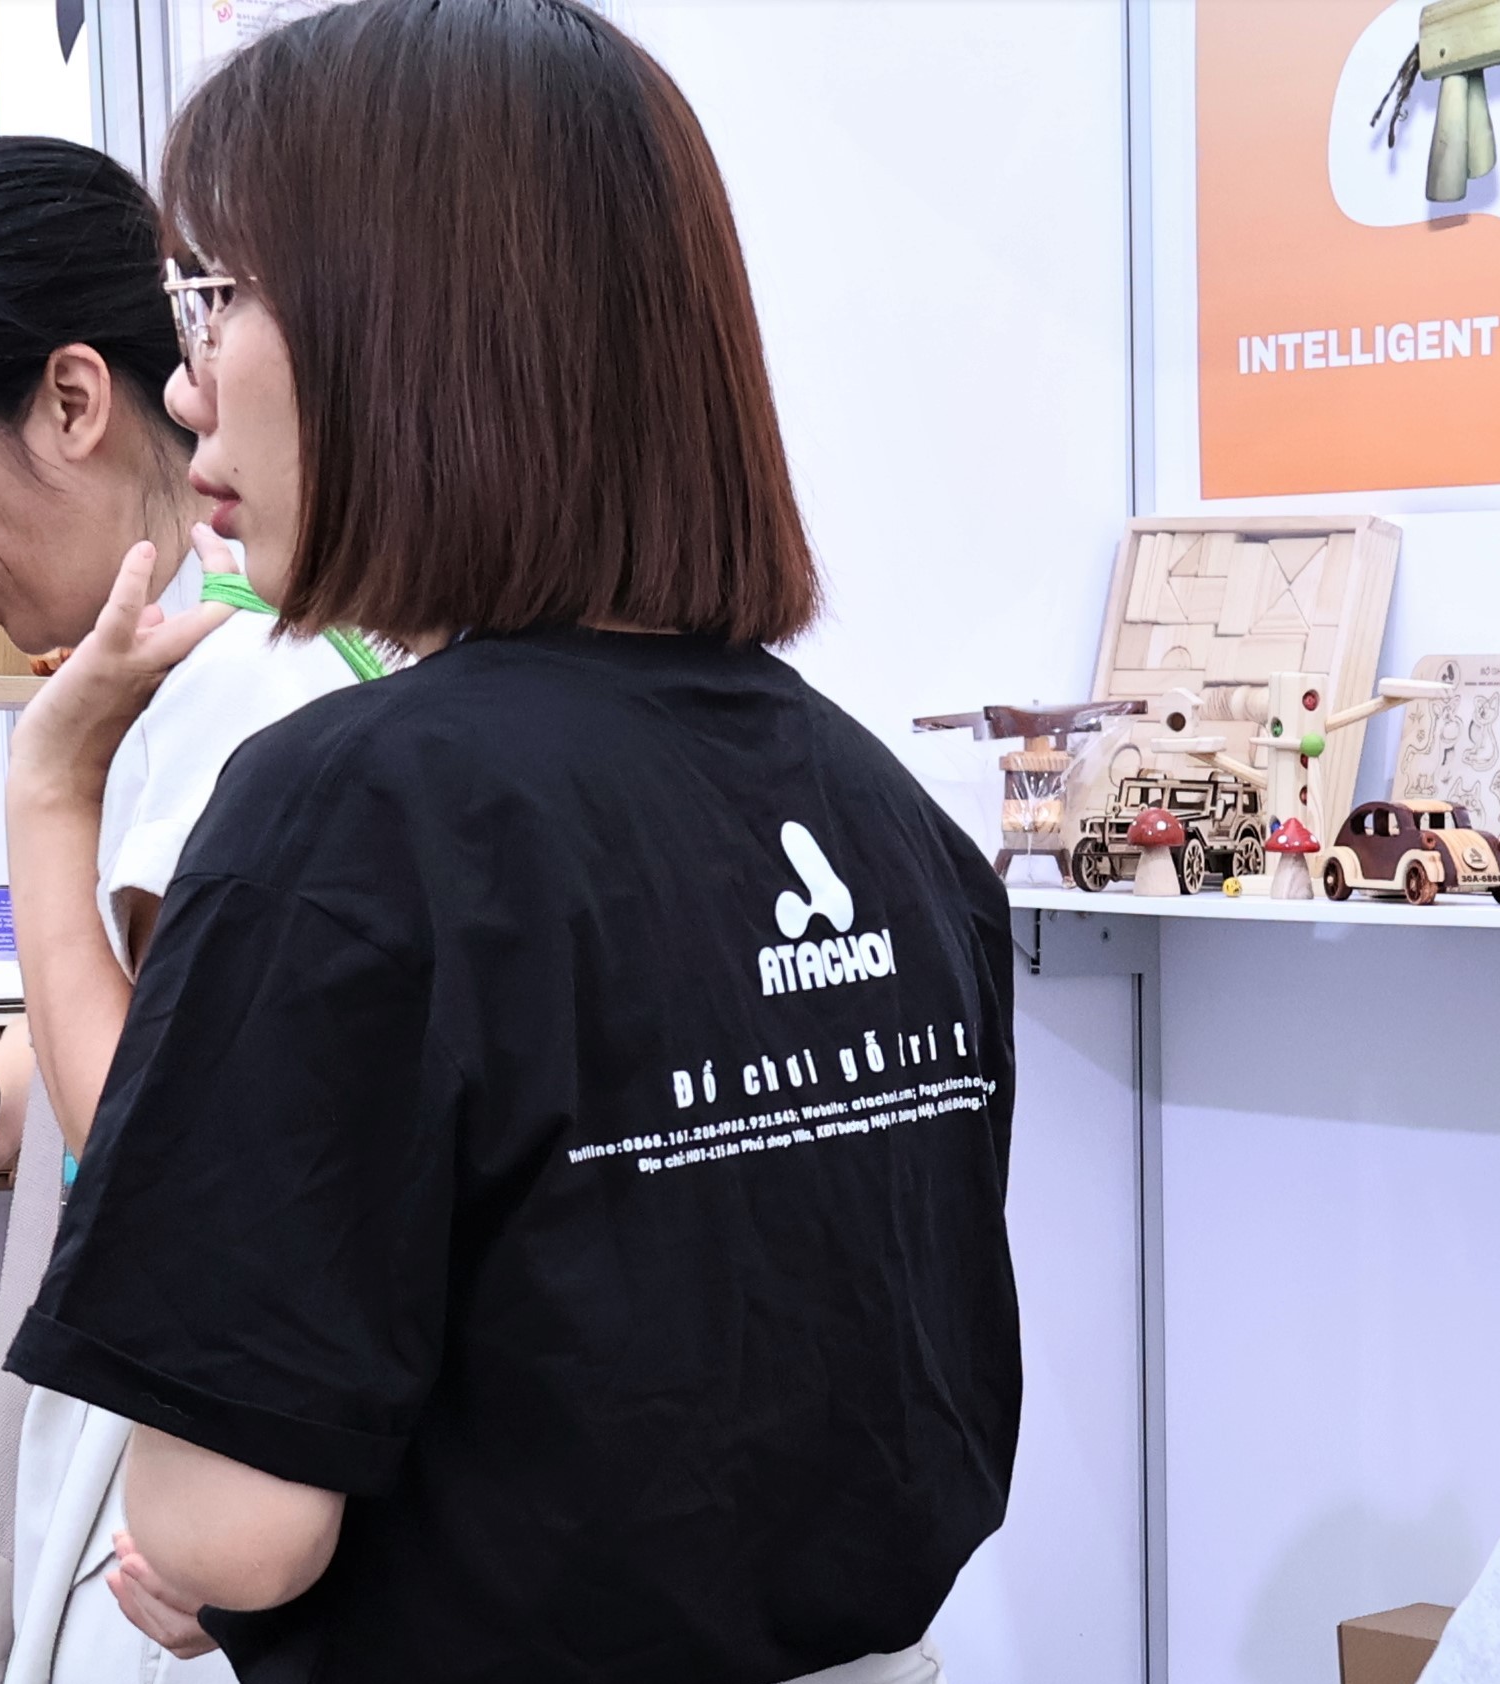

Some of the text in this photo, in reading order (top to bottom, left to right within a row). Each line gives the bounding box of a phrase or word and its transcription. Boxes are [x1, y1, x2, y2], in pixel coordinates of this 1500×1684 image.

[1238, 315, 1499, 375] INTELLIGENT
[757, 928, 897, 997] ATACHOI
[672, 1059, 718, 1109] Đồ
[742, 1049, 819, 1096] chơi
[838, 1029, 886, 1083] gỗ
[740, 1135, 765, 1153] Phú
[766, 1131, 792, 1150] shop
